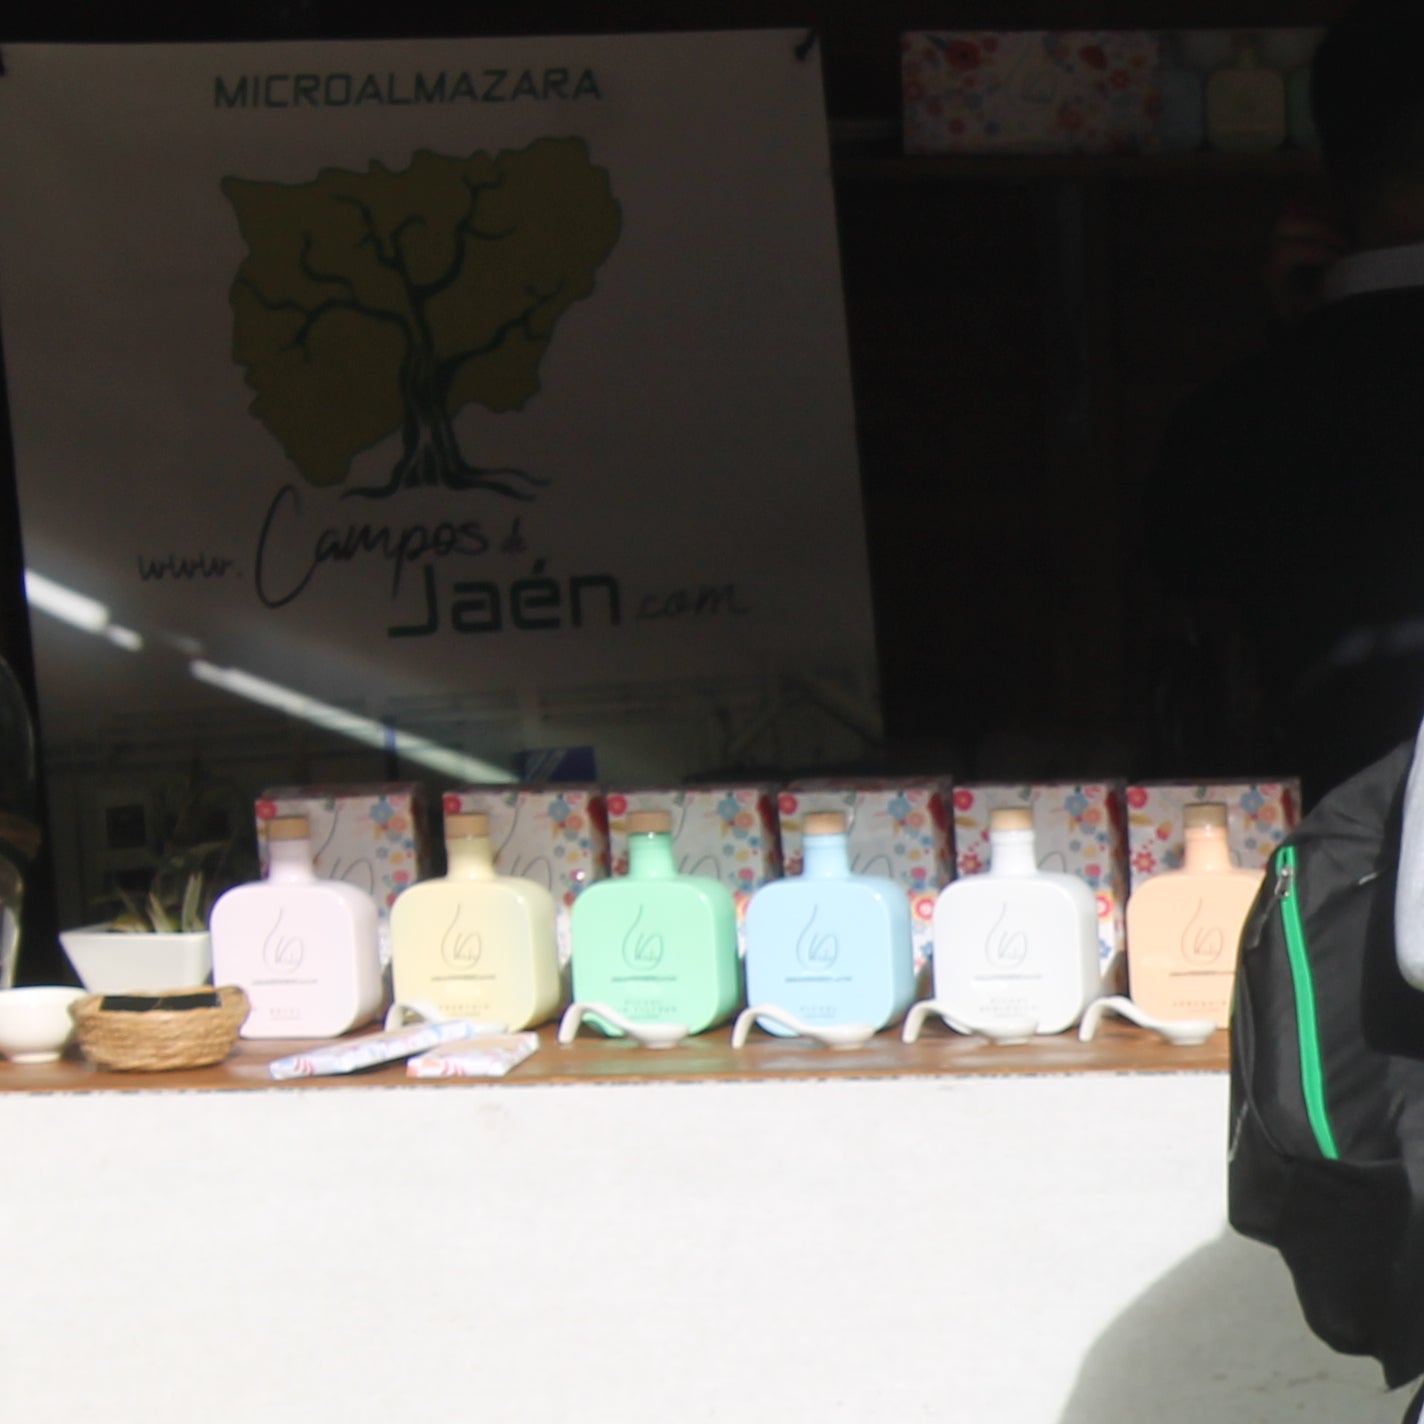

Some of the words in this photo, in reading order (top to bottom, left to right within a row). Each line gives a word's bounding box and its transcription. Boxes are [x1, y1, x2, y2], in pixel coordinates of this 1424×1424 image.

[213, 67, 602, 109] MICROALMAZARA
[254, 484, 491, 609] Campos
[387, 558, 621, 638] Jaén
